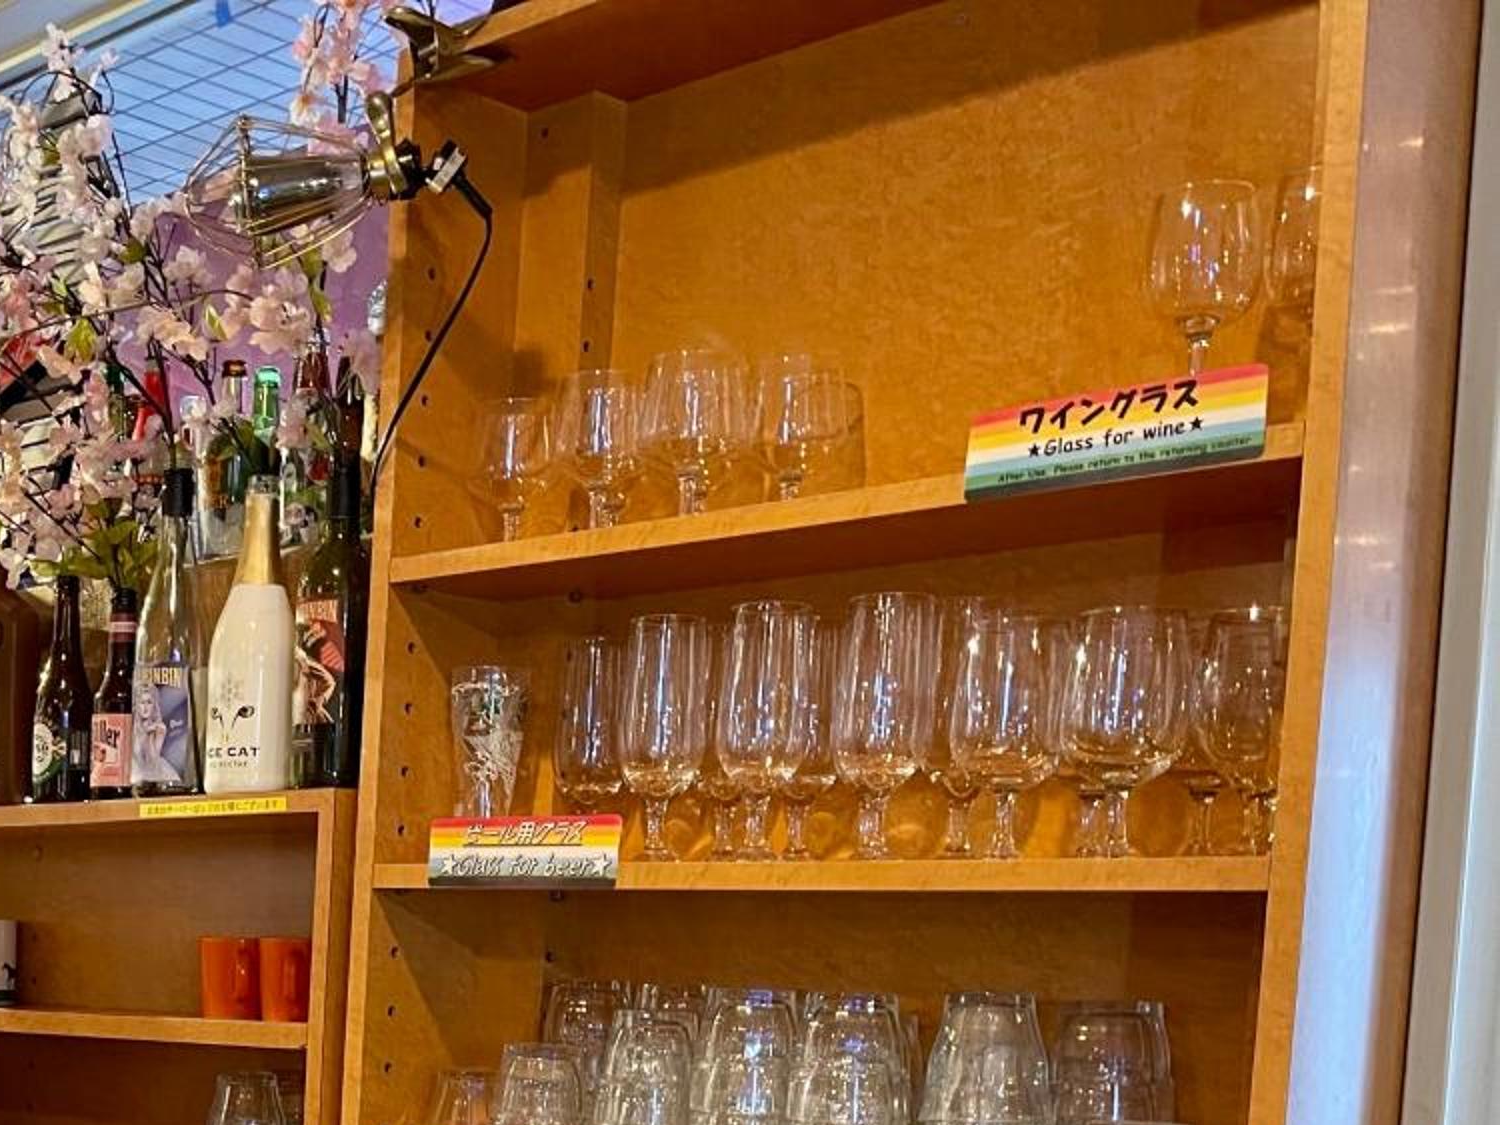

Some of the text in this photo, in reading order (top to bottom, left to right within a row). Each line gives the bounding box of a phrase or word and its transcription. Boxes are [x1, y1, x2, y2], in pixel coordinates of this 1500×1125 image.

[1019, 379, 1199, 434] ワイングラス
[1043, 421, 1186, 458] Glass for wine
[1088, 456, 1121, 469] return
[1139, 449, 1156, 462] the
[227, 747, 259, 758] CAT
[465, 821, 588, 845] ビール用グラス
